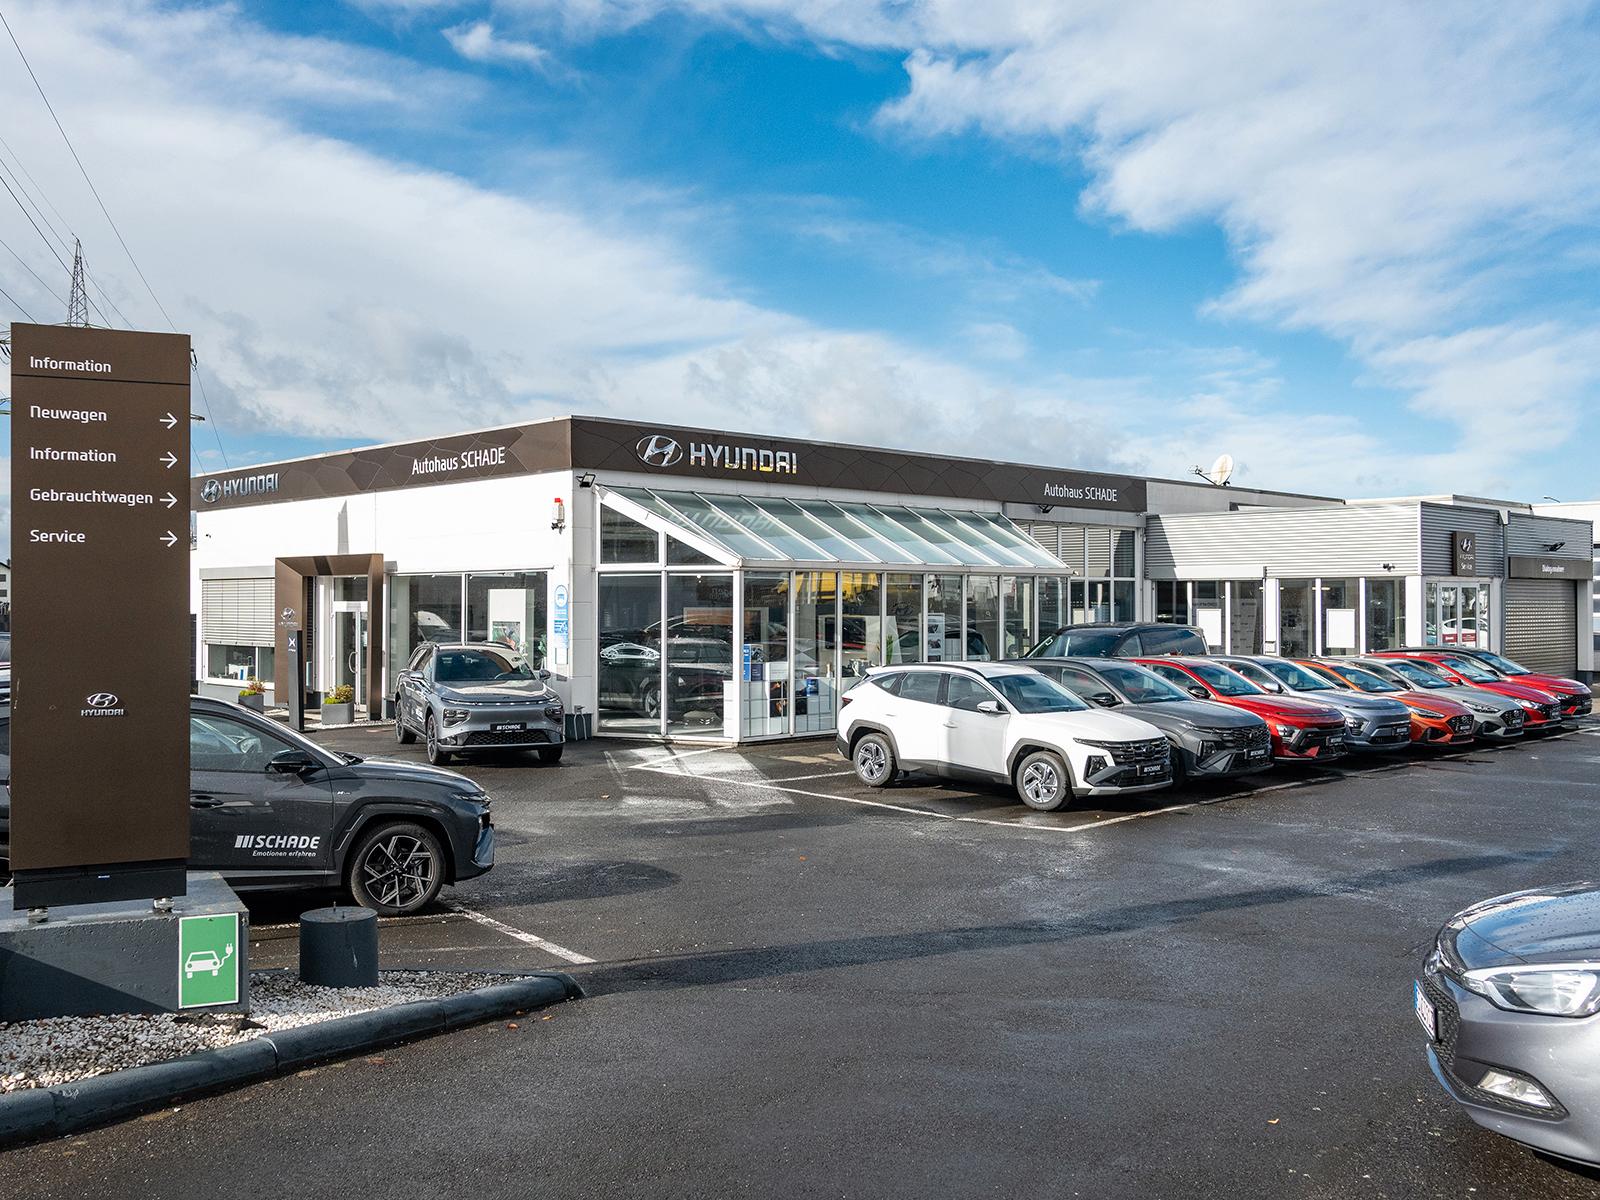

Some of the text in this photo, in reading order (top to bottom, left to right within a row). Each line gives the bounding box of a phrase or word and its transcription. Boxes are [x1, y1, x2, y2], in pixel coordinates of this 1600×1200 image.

[30, 356, 112, 373] Information
[30, 405, 107, 424] Neuwagen
[30, 447, 117, 462] Information
[411, 446, 505, 475] Autohaus SCHADE
[686, 442, 797, 474] HYUNDAI
[223, 473, 279, 497] HYUNDAI
[1043, 482, 1118, 502] Autohaus SCHADE
[30, 488, 153, 506] Gebrauchtwagen
[30, 529, 86, 543] Service
[80, 708, 124, 717] HYUNDAI
[255, 835, 320, 849] SCHADE
[288, 850, 317, 858] erfahren
